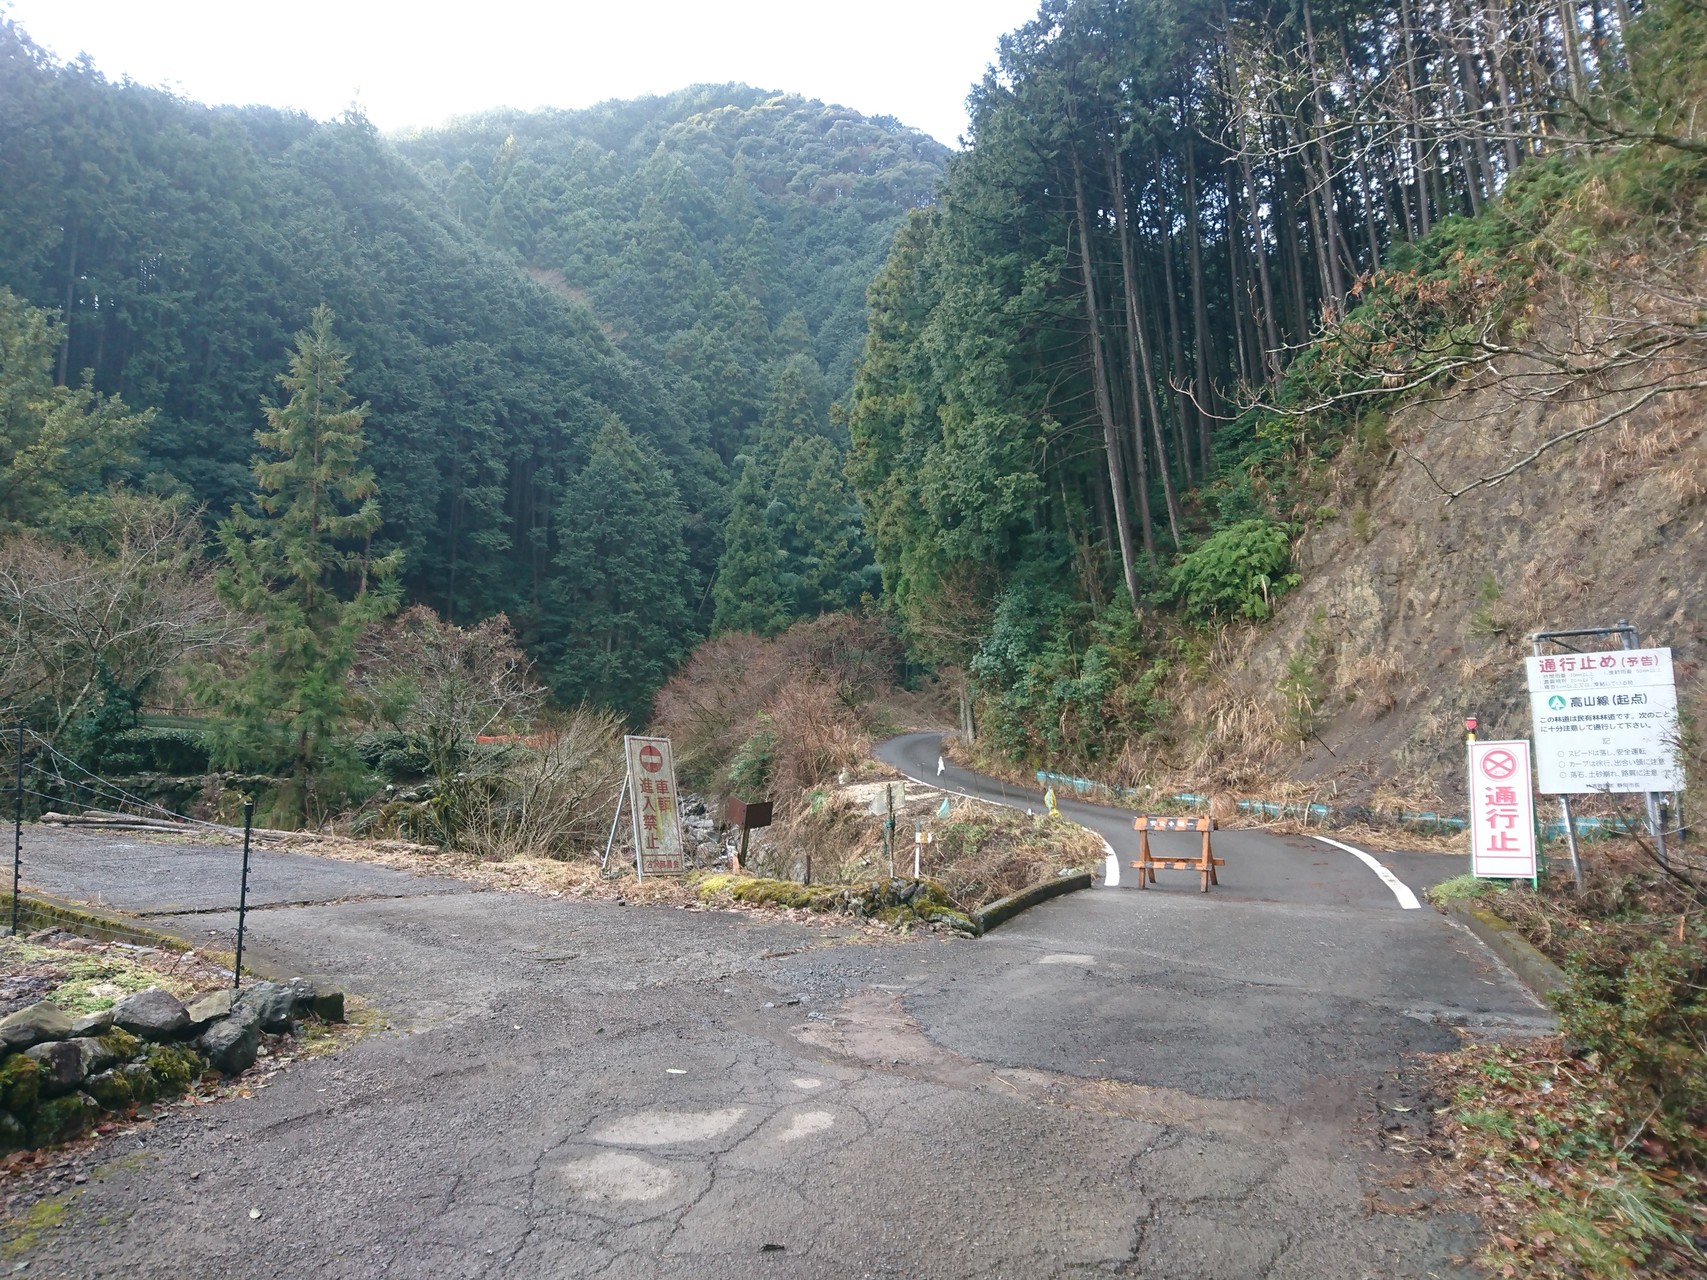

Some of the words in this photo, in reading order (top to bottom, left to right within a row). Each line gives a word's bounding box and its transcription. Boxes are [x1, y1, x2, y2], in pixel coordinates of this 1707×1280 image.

[1539, 655, 1659, 673] 通行止め(予告)
[1569, 693, 1648, 708] 高山線(起点)
[639, 777, 660, 849] 進入禁止
[1485, 786, 1520, 852] 通行止
